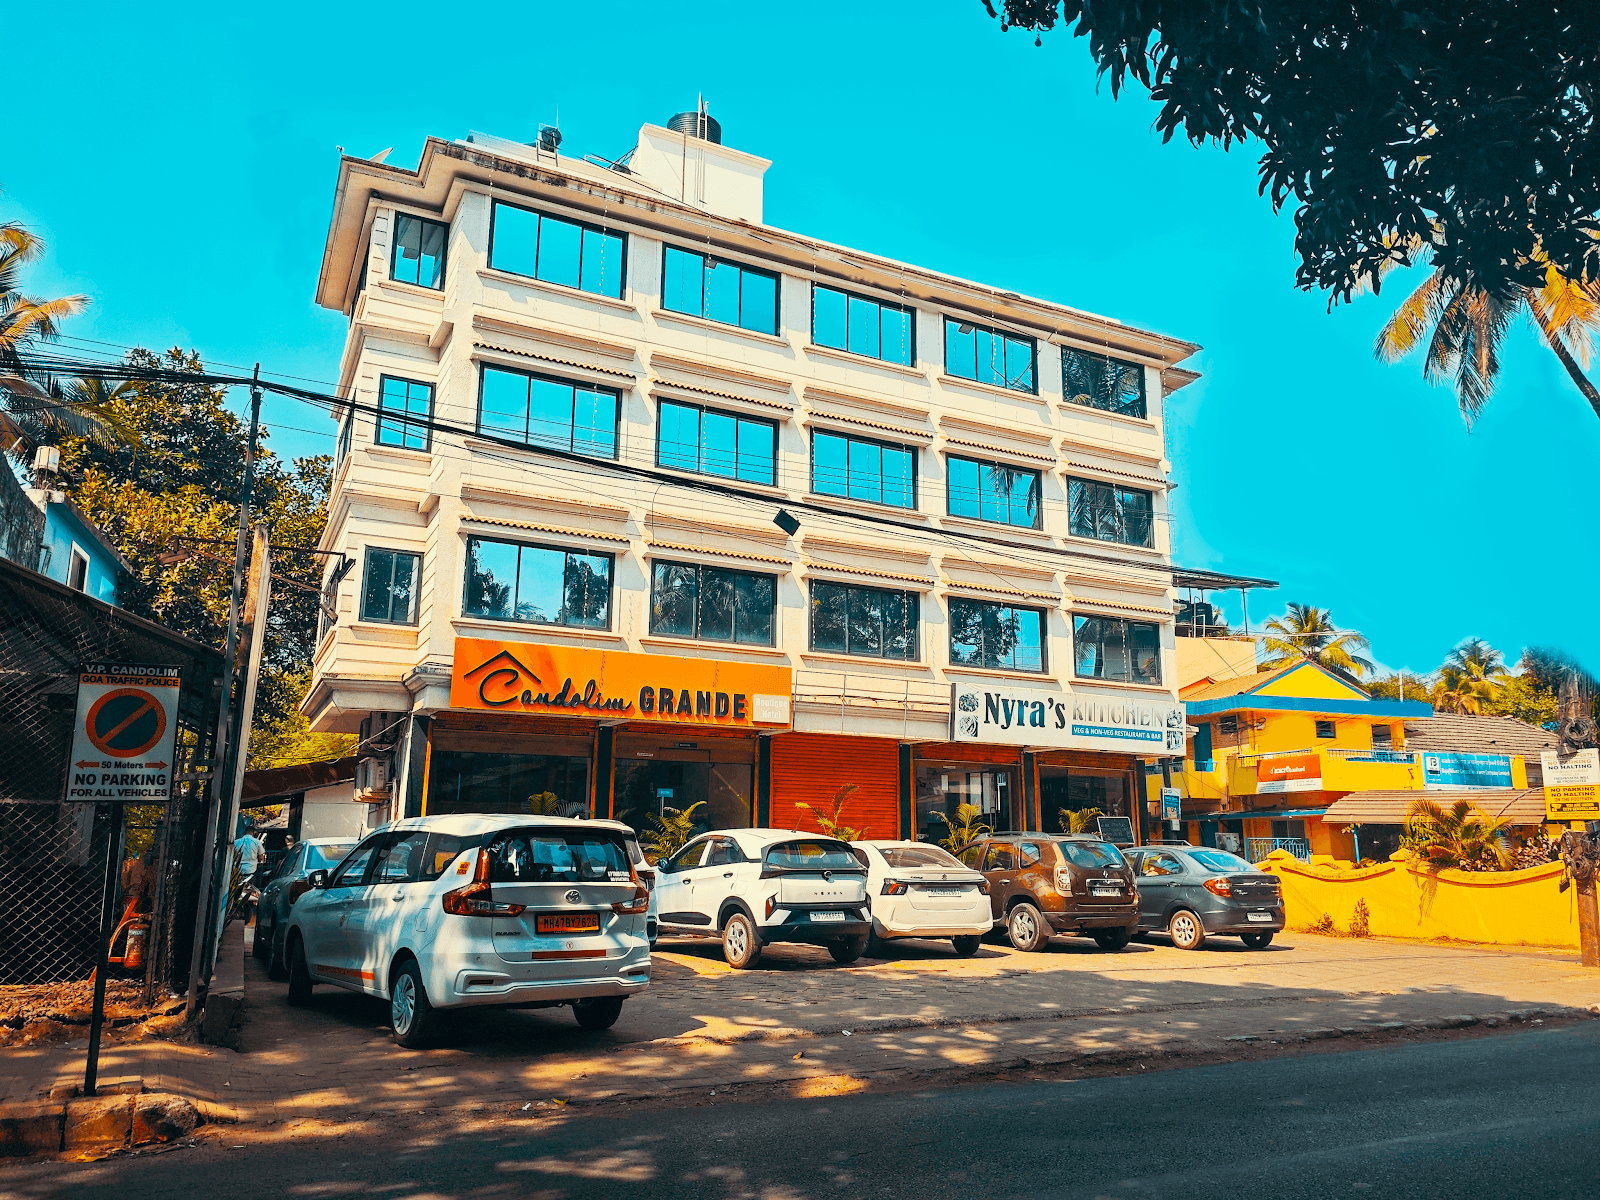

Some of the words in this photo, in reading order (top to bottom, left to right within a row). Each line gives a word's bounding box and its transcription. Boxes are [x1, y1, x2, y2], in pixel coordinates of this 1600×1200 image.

[86, 664, 107, 674] V.P.
[110, 665, 178, 677] CANDOLIM
[82, 675, 104, 684] GOA
[105, 676, 144, 686] TRAFFIC
[146, 677, 179, 687] POLICE
[479, 668, 633, 711] Candolim
[639, 686, 747, 719] GRANDE
[755, 697, 788, 708] Boutique
[762, 710, 781, 719] Hotel
[984, 692, 1066, 730] Nyra's
[1072, 702, 1164, 728] KITCHEN
[1090, 728, 1114, 736] NON-VEG
[1114, 731, 1146, 739] RESTAURANT
[101, 761, 112, 769] 50
[114, 761, 144, 770] Meters
[74, 773, 97, 786] NO
[101, 773, 166, 786] PARKING
[70, 788, 93, 797] FOR
[94, 788, 115, 797] ALL
[117, 788, 168, 798] VEHICLES
